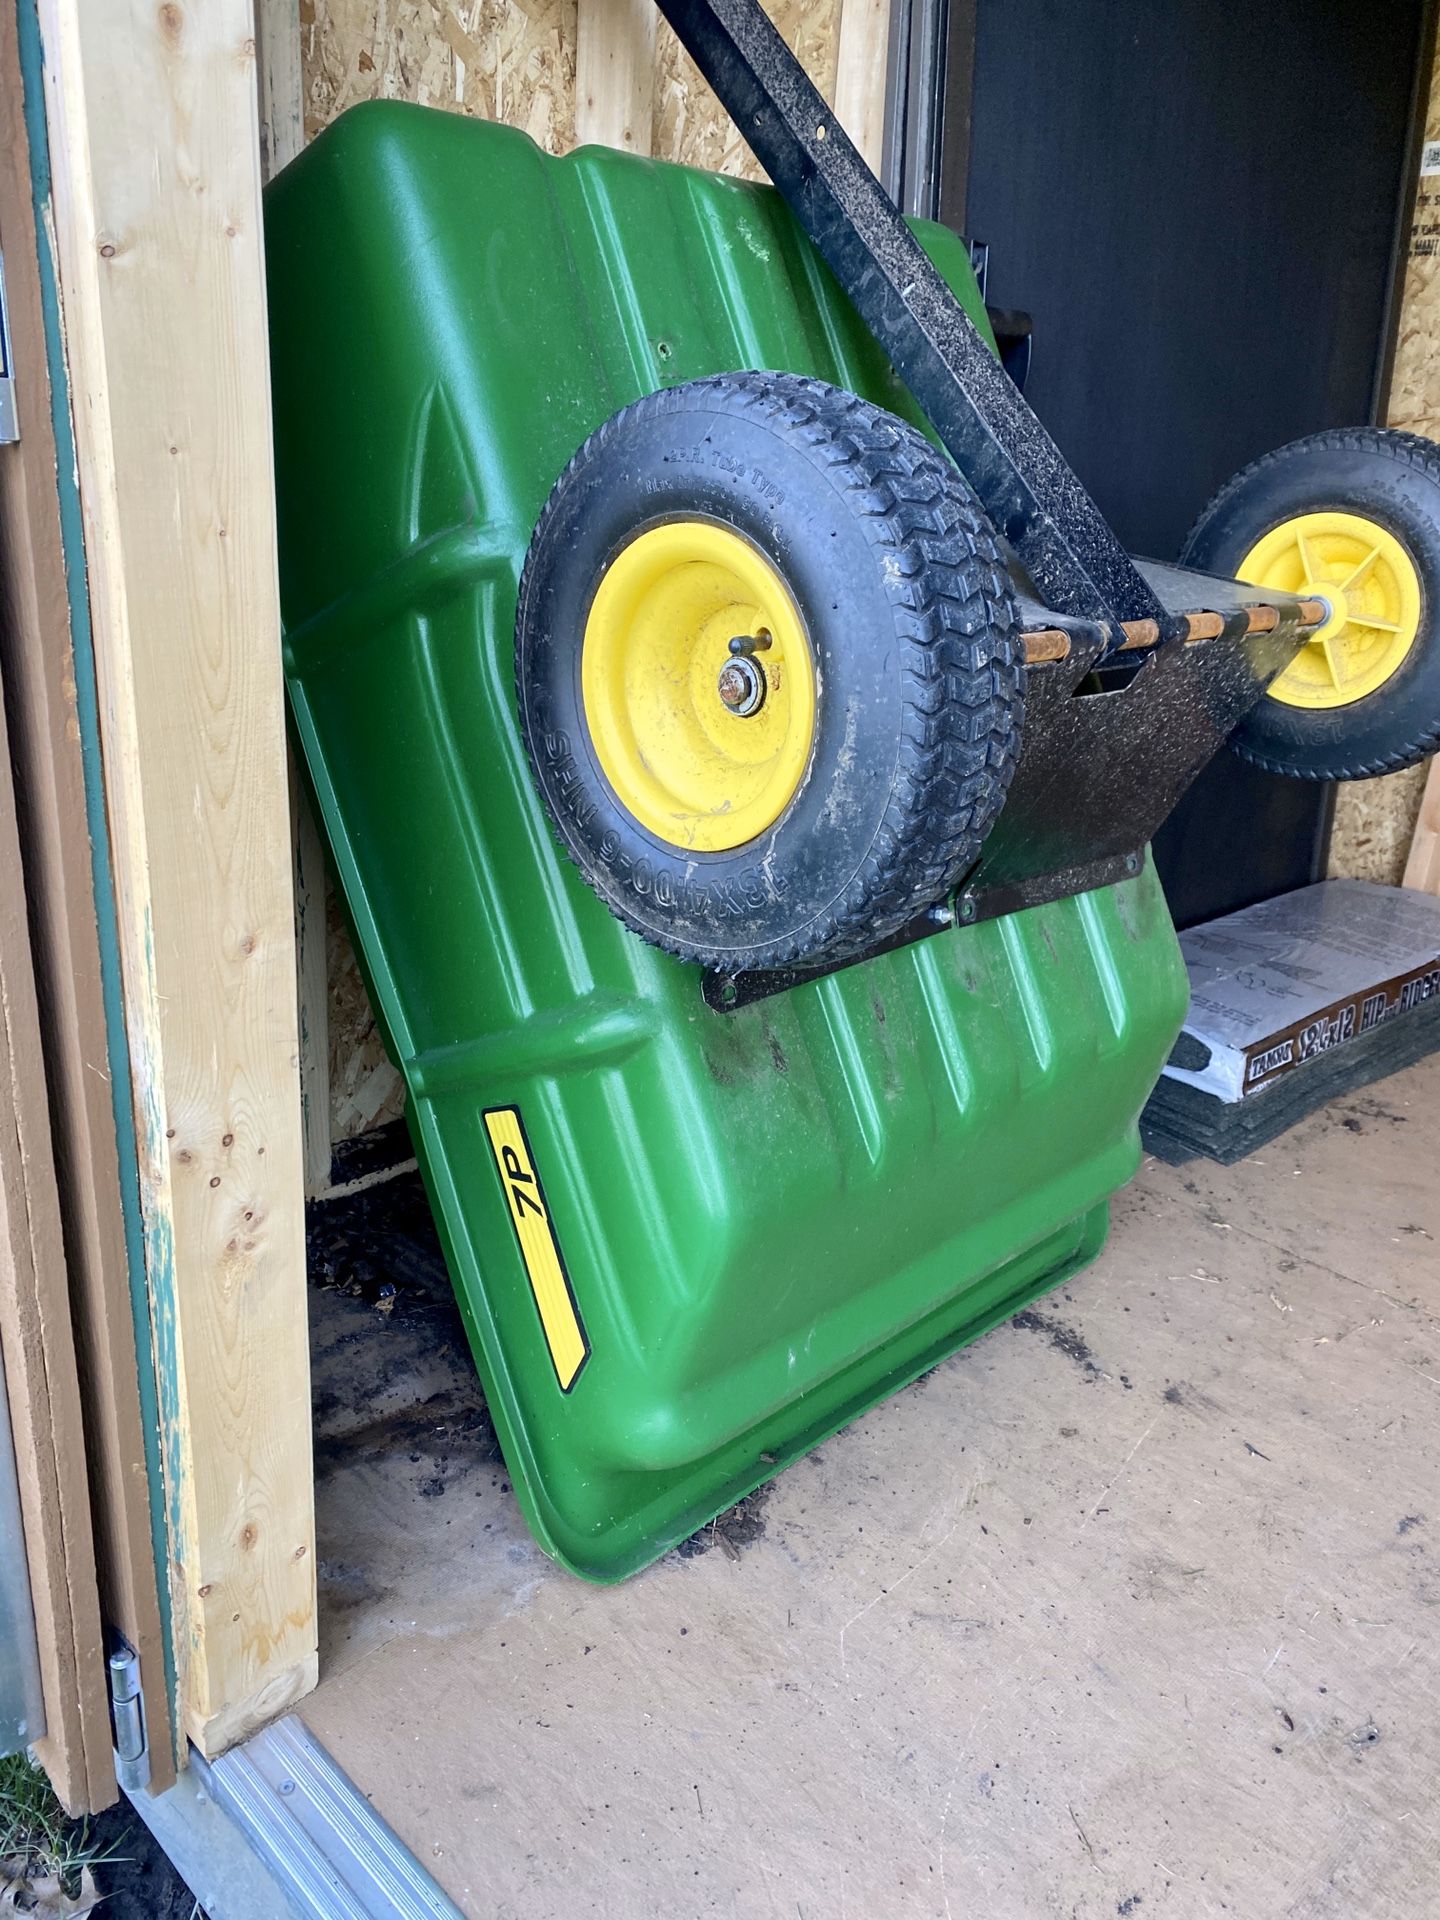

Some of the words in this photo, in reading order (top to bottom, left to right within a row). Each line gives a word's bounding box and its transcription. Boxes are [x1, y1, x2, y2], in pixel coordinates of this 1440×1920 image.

[712, 450, 747, 478] Tube
[751, 467, 786, 506] Type
[546, 728, 599, 828] NHS
[1360, 993, 1386, 1031] HIP
[502, 1145, 544, 1218] 7P
